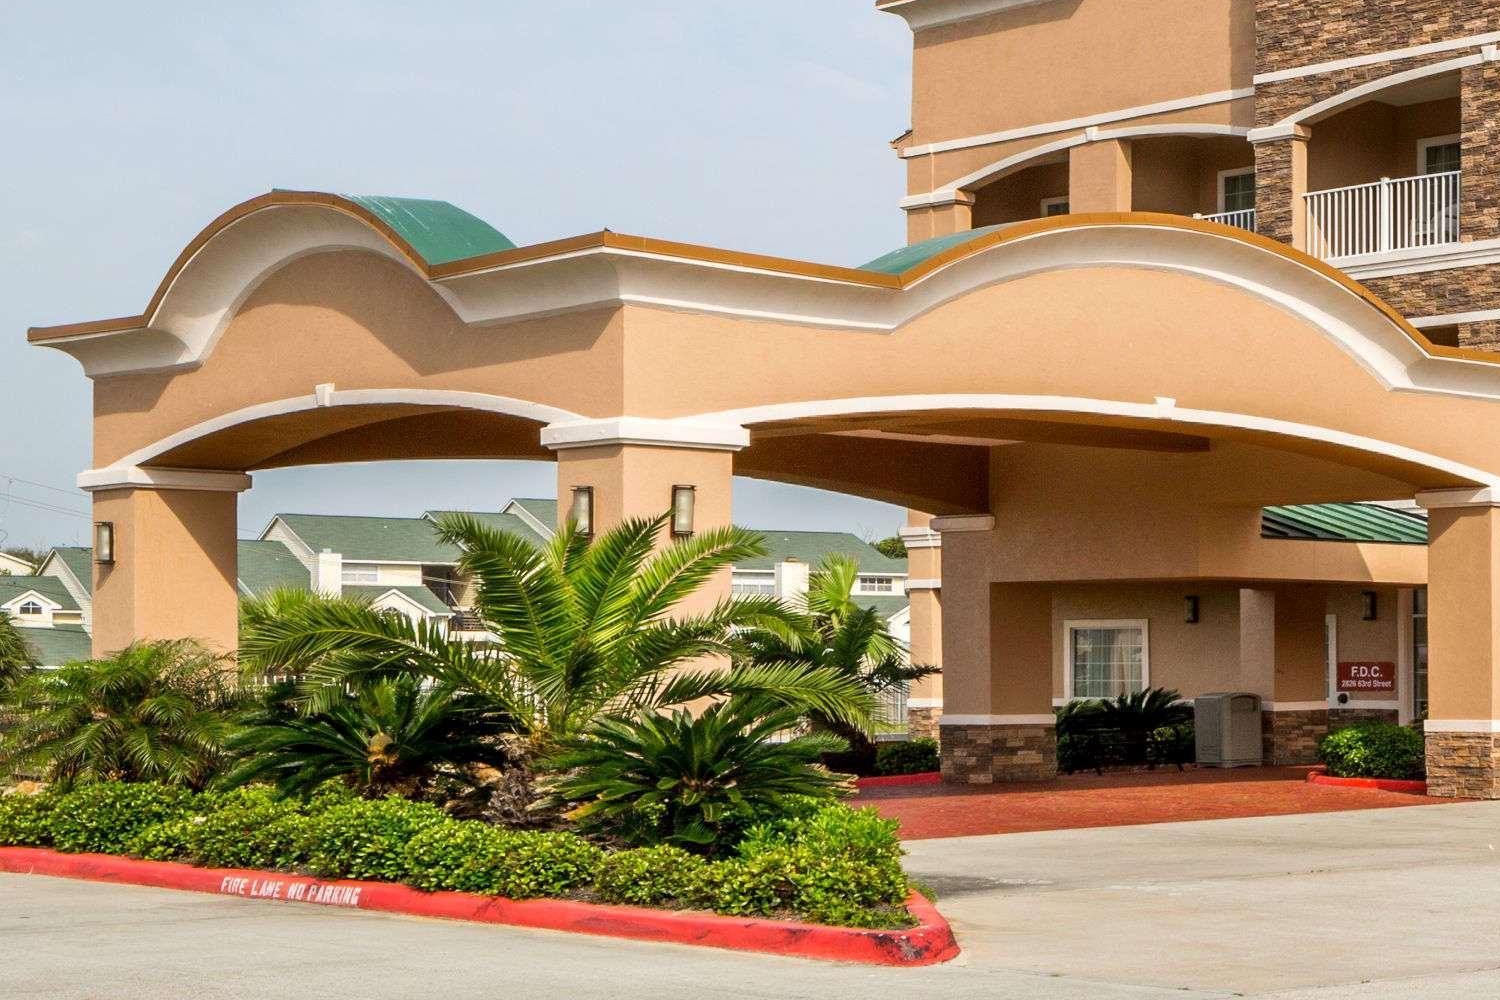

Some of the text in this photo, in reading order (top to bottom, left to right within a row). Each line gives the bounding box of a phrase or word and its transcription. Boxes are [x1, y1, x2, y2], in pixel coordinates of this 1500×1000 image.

[1351, 665, 1383, 678] F.D.C.
[1372, 680, 1392, 688] Street
[221, 876, 362, 906] FIRE LANE NO PARKING
